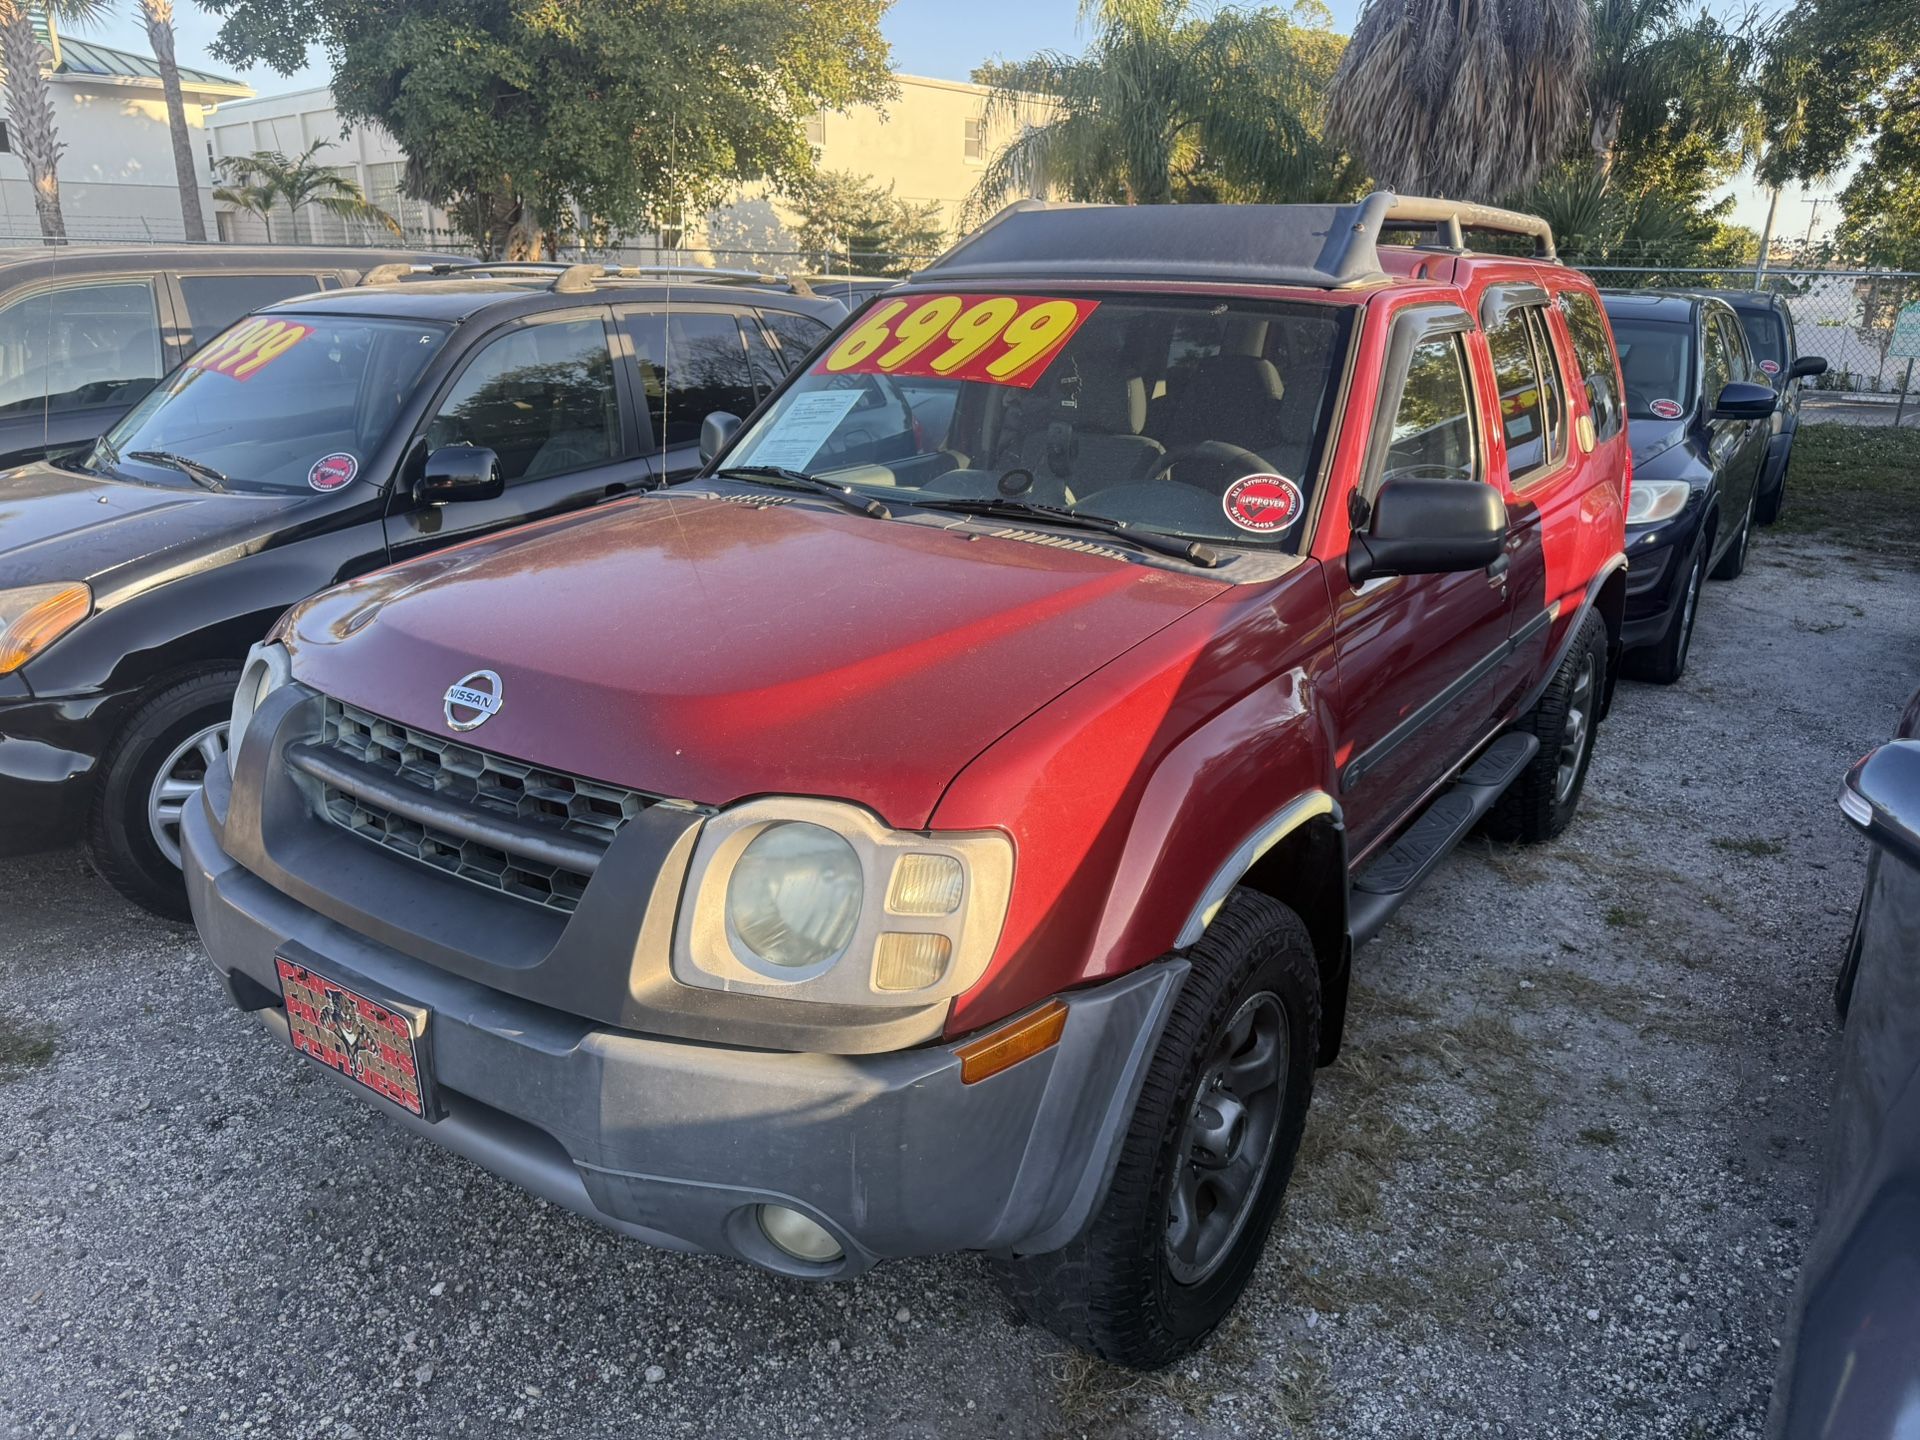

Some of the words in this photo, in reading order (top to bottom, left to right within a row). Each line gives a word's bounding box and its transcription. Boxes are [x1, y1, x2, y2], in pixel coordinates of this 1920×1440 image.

[825, 296, 1078, 381] 6999
[1231, 487, 1243, 498] ALL
[1243, 478, 1279, 488] APPROVED
[448, 688, 492, 708] NISSAN
